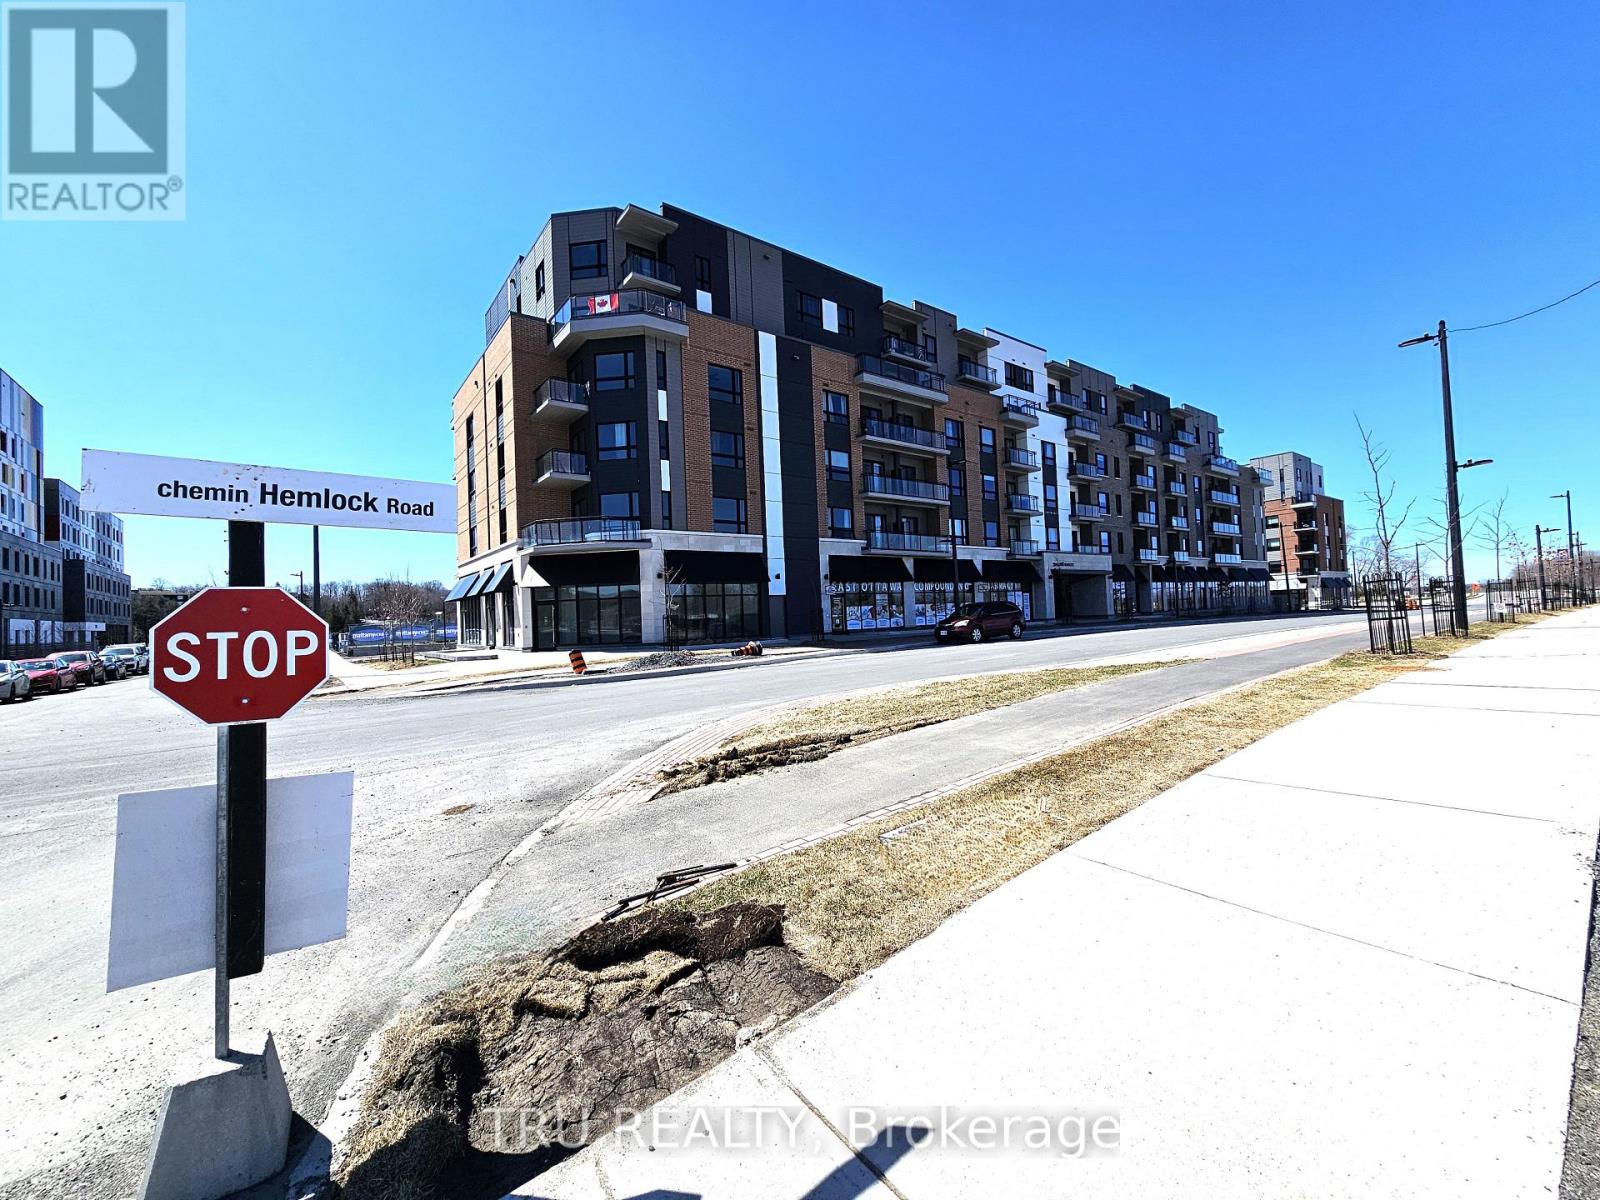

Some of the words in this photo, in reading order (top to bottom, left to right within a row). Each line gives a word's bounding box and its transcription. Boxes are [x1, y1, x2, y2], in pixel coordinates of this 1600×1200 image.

[157, 480, 249, 503] chemin
[259, 482, 379, 513] Hemlock
[387, 498, 434, 517] Road
[914, 582, 972, 591] COMPOUNDNG
[163, 630, 319, 683] STOP
